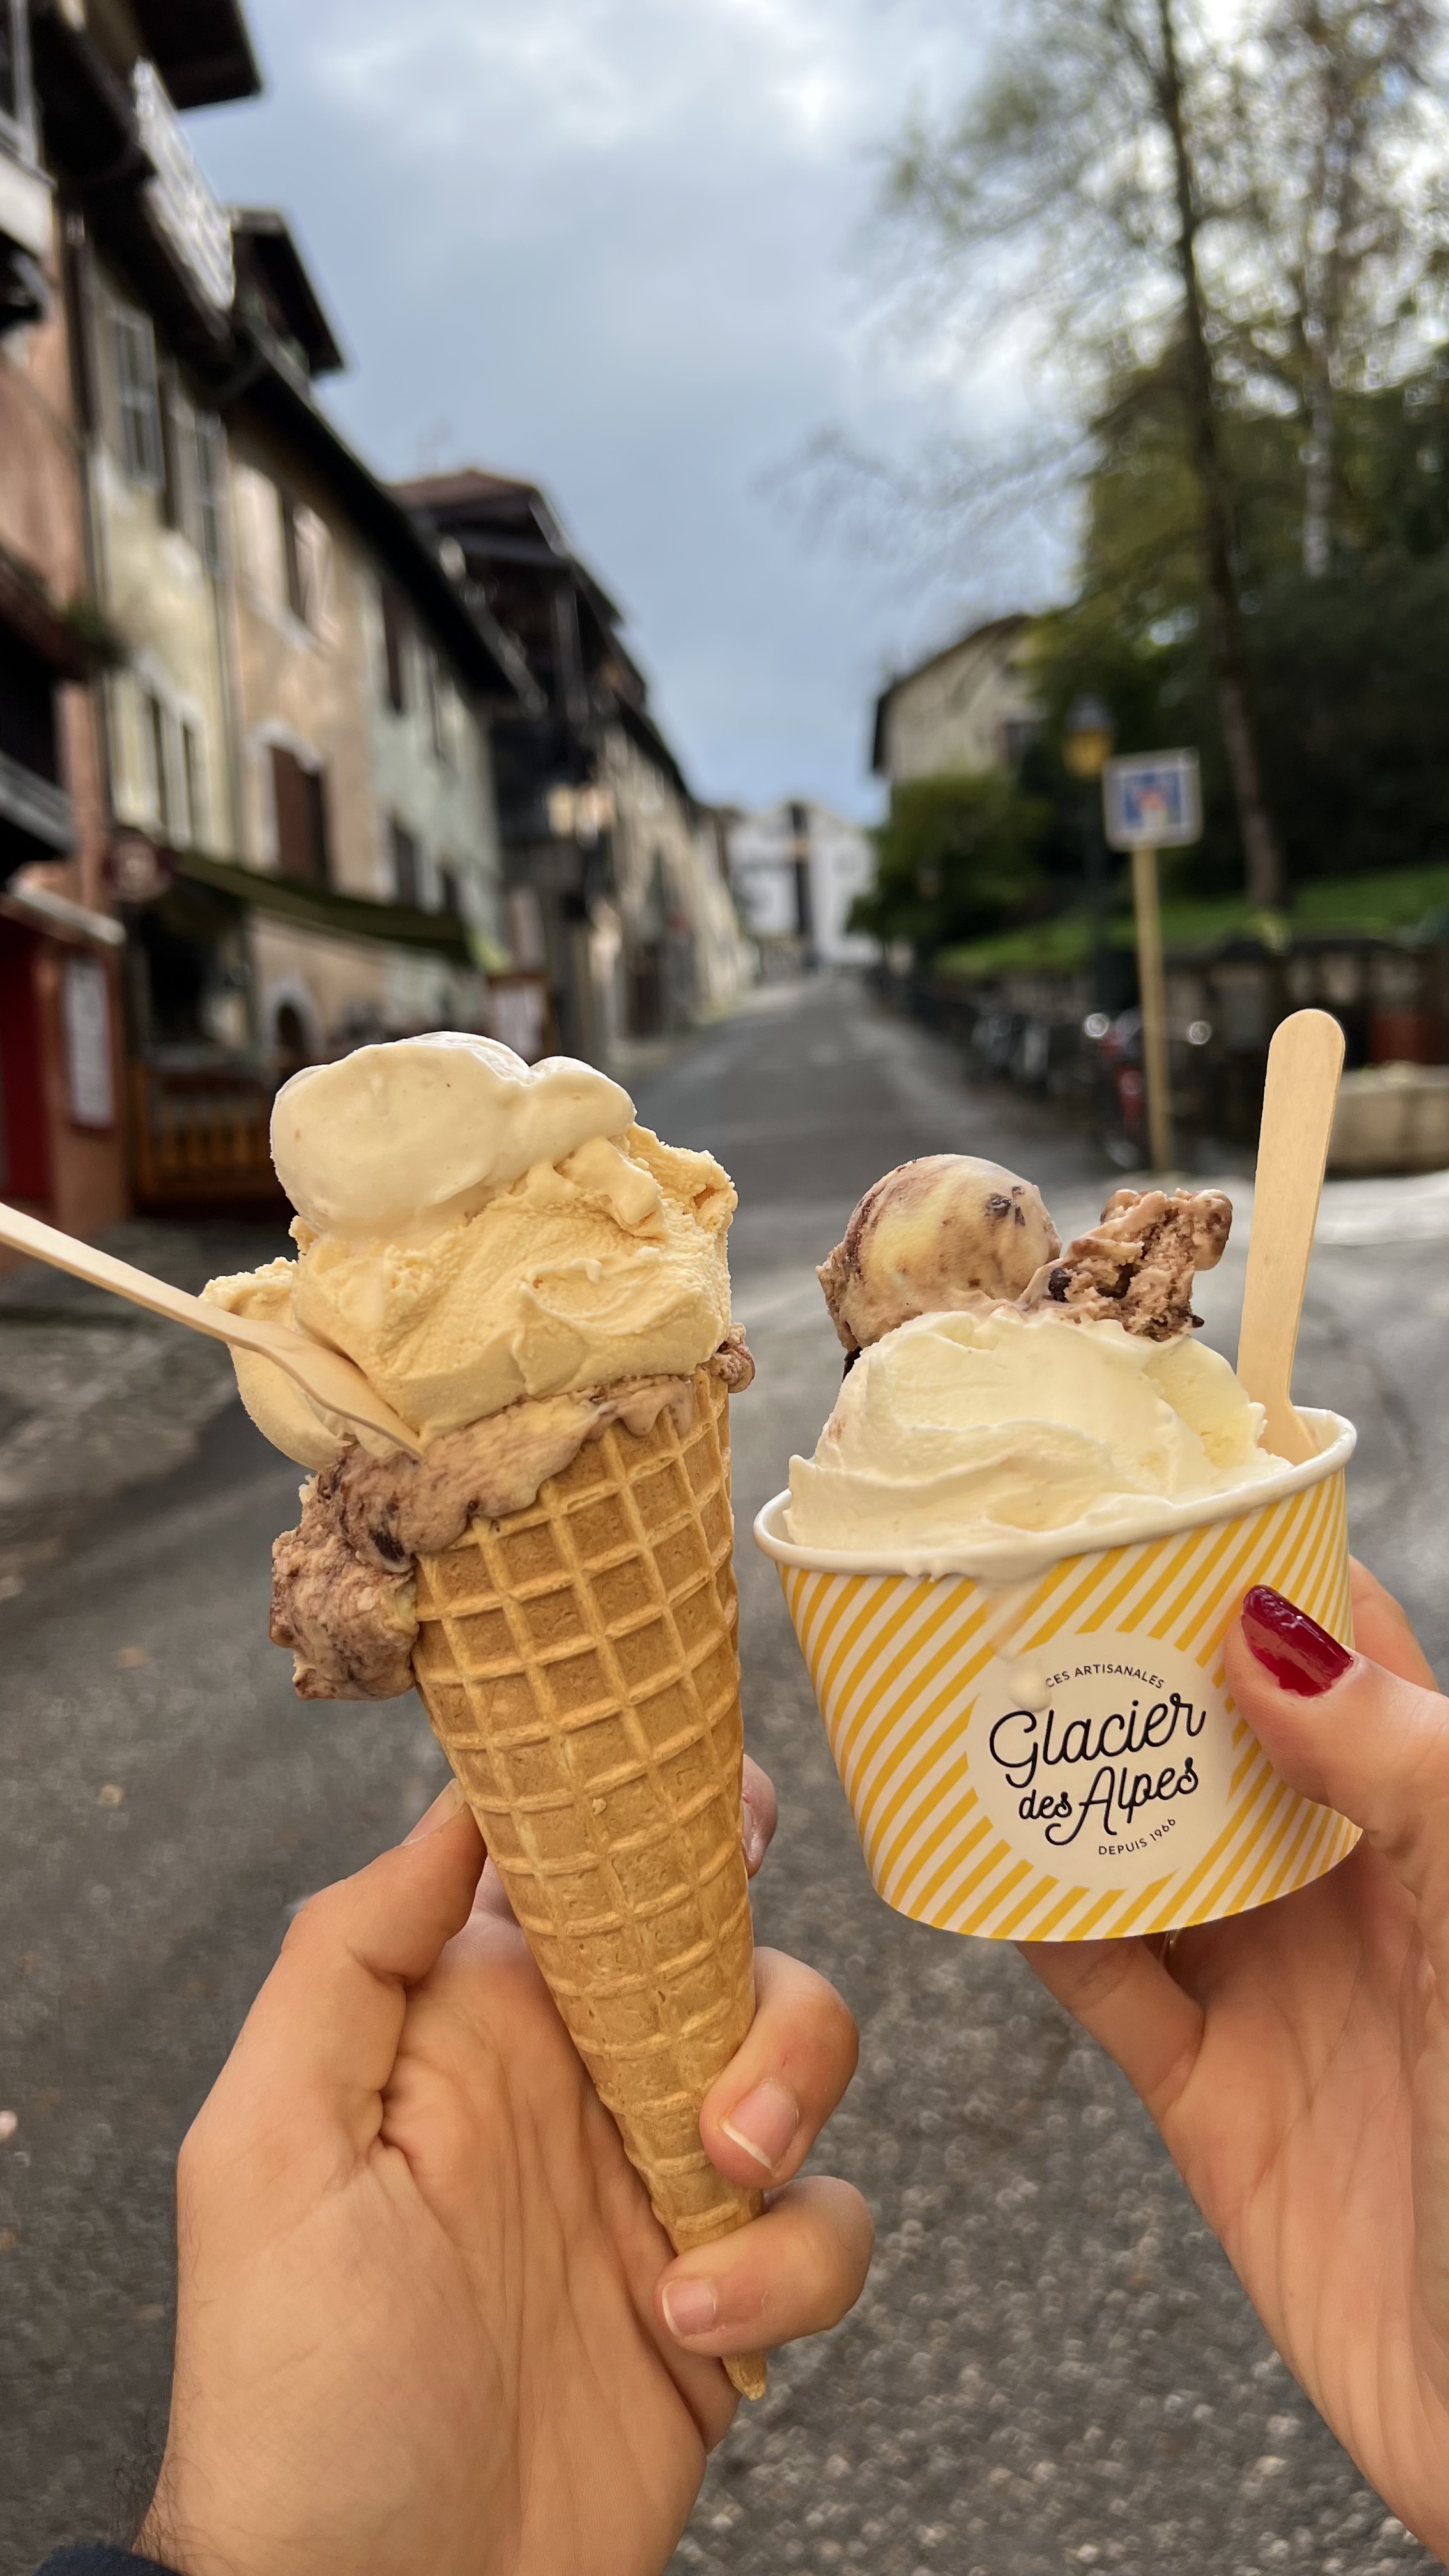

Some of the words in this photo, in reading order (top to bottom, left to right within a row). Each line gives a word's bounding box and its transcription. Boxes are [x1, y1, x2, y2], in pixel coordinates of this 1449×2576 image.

[1045, 1670, 1071, 1688] CES
[1075, 1664, 1164, 1689] ARTISANALES
[989, 1692, 1206, 1788] Glacier
[1018, 1789, 1073, 1820] des
[1045, 1757, 1199, 1846] Alpes
[1098, 1837, 1147, 1855] DEPUIS
[1149, 1818, 1176, 1841] 1966
